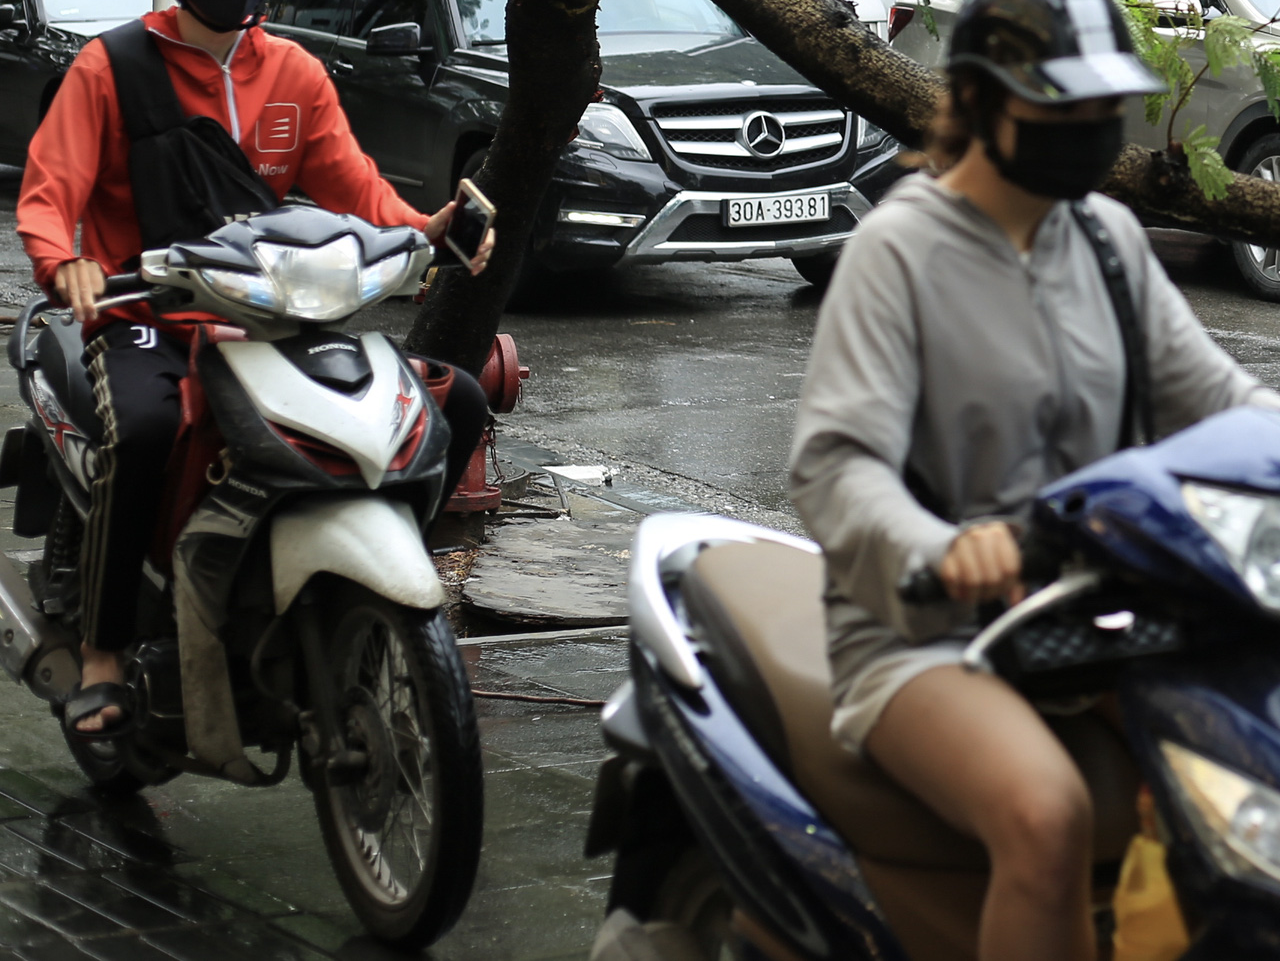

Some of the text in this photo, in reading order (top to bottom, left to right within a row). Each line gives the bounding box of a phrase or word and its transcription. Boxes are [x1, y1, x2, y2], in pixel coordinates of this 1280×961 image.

[258, 163, 288, 176] Now
[731, 196, 826, 222] 30A-393.81
[307, 342, 357, 355] HONDA
[228, 478, 269, 499] HONDA
